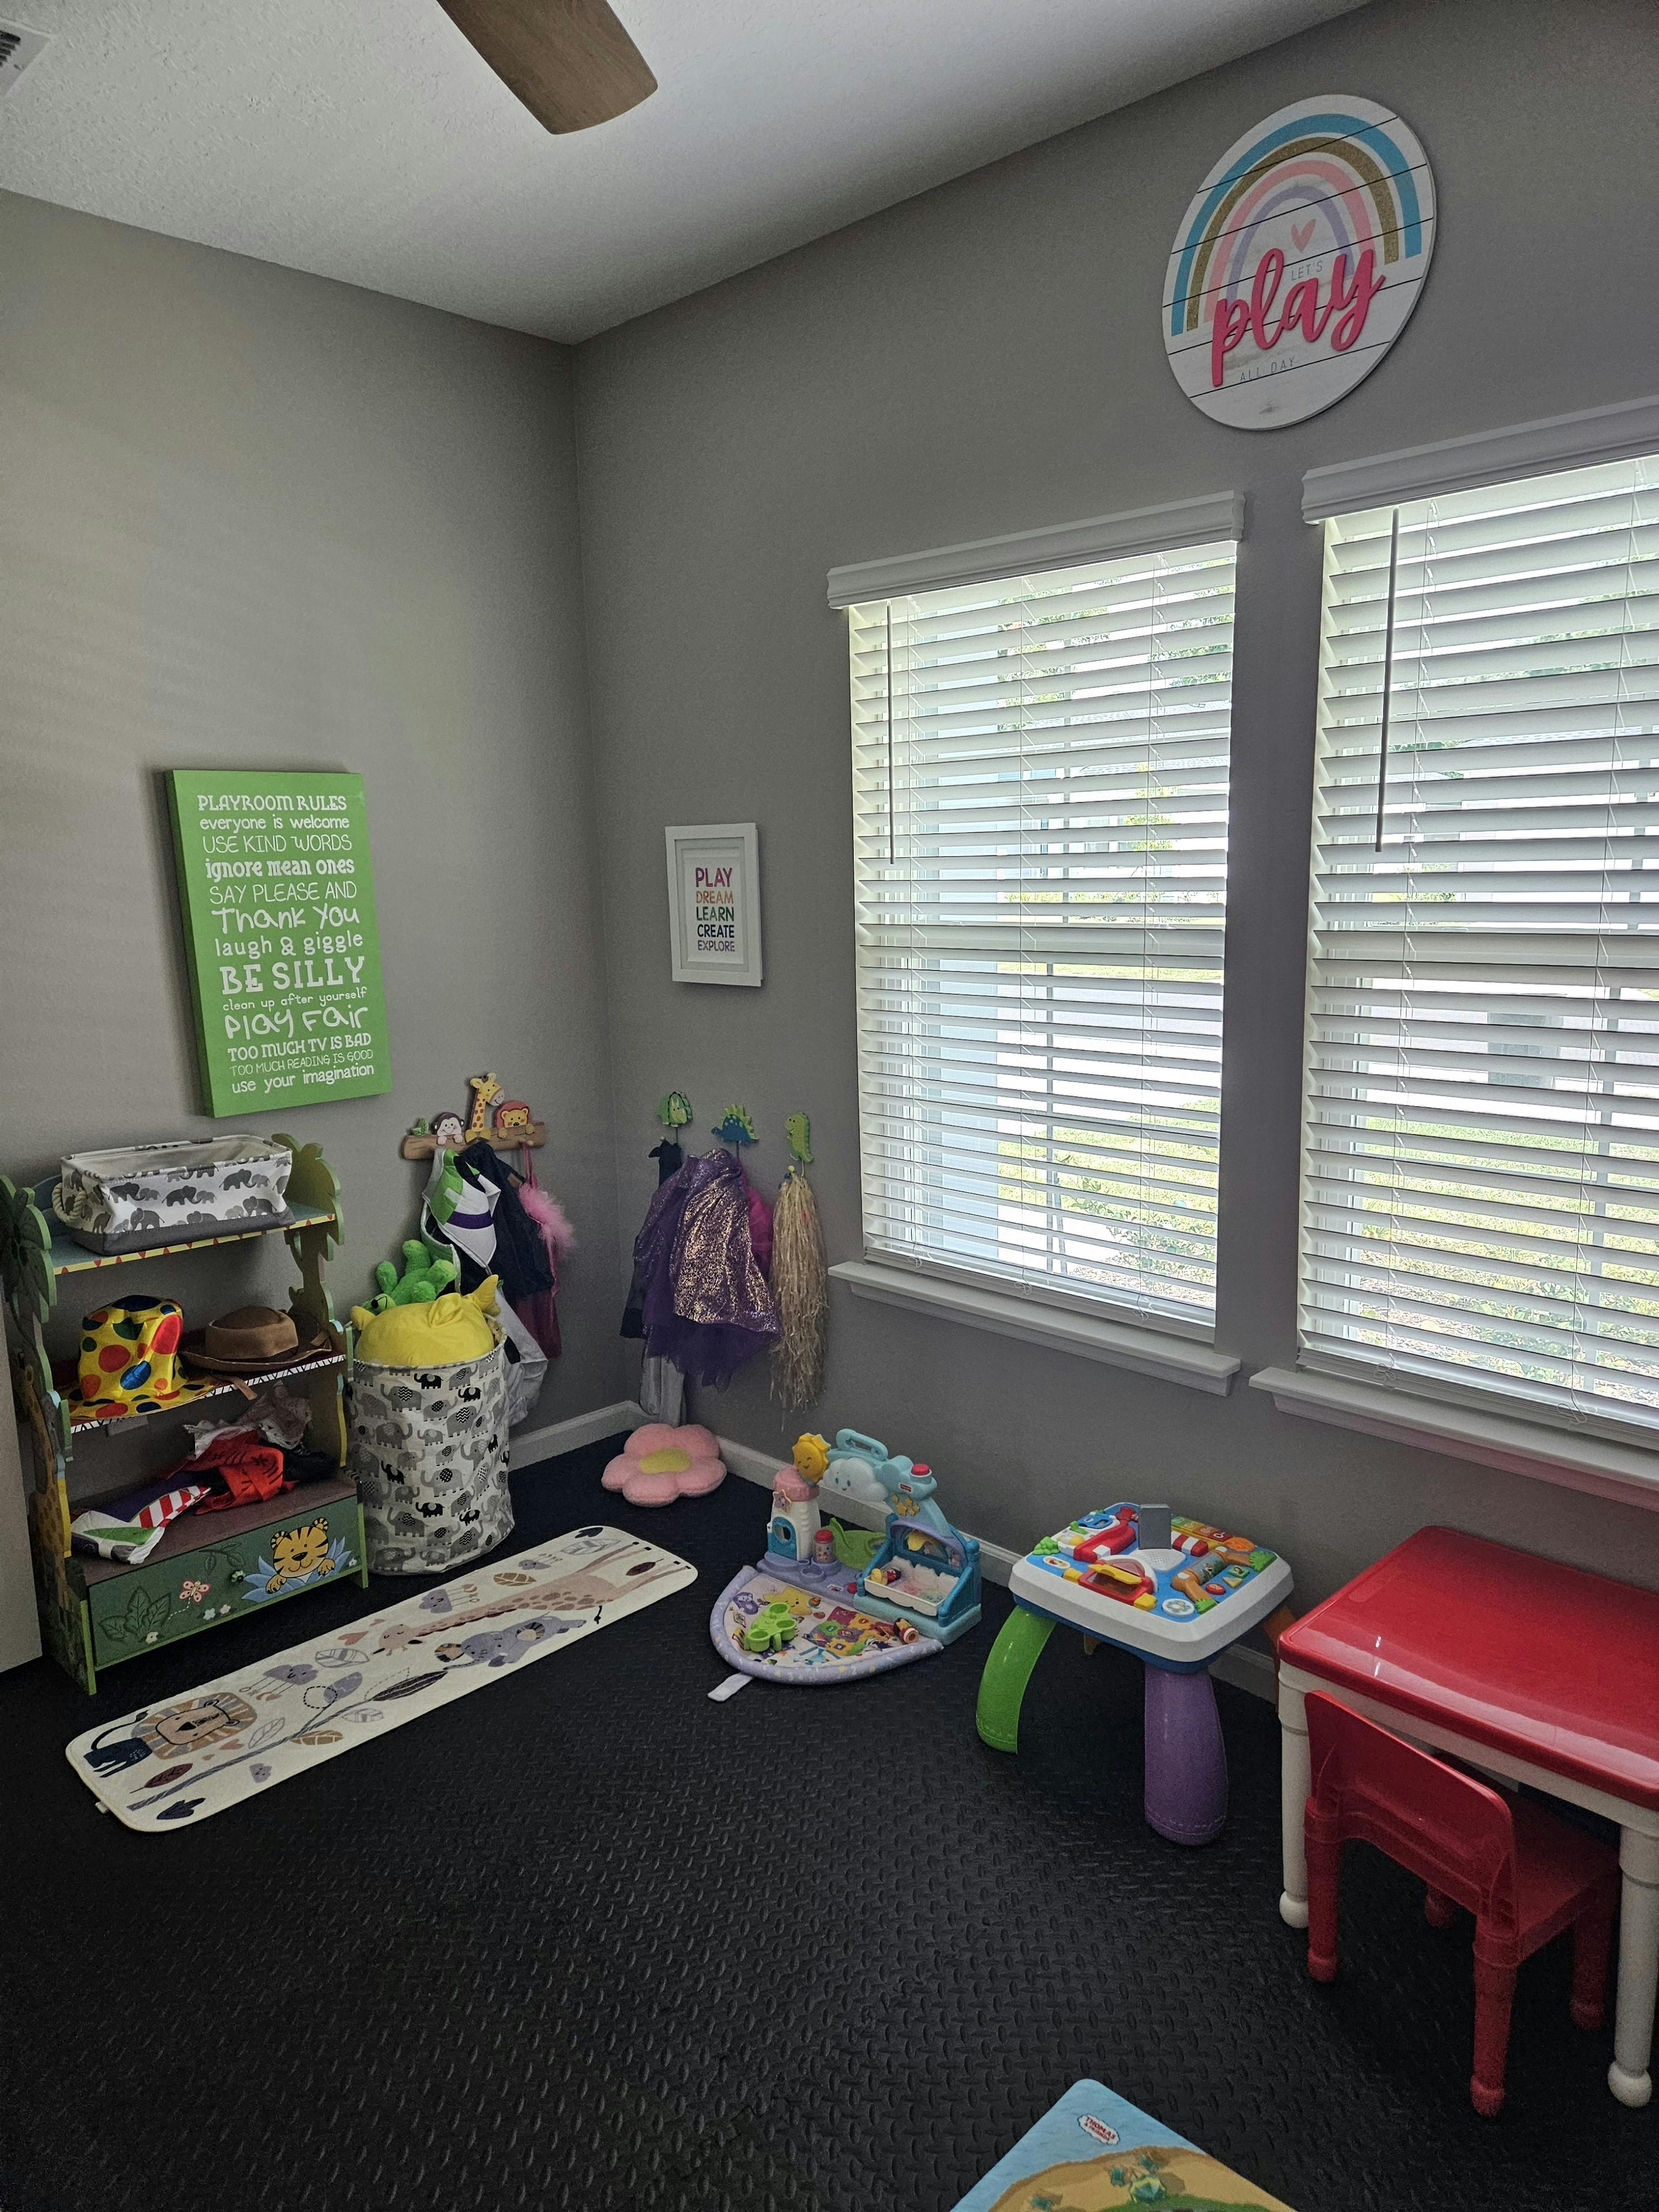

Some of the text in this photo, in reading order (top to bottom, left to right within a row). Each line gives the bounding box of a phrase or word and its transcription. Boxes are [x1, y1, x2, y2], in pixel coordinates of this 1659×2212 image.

[1291, 260, 1323, 281] LET'S
[1212, 248, 1386, 387] play
[1240, 356, 1295, 382] ALL DAY
[197, 795, 347, 811] PLAYROOM RULES
[200, 814, 349, 833] everyone is welcome
[203, 834, 352, 853] USE KIND WORDS
[205, 858, 355, 883] ignore mean ones
[695, 867, 733, 888] PLAY
[210, 880, 357, 904] SAY PLEASE AND
[696, 890, 734, 904] DREAM
[211, 902, 360, 934] Thank You
[696, 906, 734, 921] LEARN
[697, 924, 735, 938] CREATE
[215, 930, 363, 959] laugh & giggle
[697, 940, 735, 952] EXPLORE
[220, 956, 365, 995] BE SILLY
[223, 986, 367, 1012] clean up after yourself
[225, 1004, 368, 1040] Play Fair
[227, 1032, 372, 1062] TOO MUCH TV IS BAD
[229, 1049, 373, 1077] TOO MUCH READING IS GOOD
[232, 1062, 374, 1094] use your imagination
[1086, 2116, 1116, 2140] THOMAS
